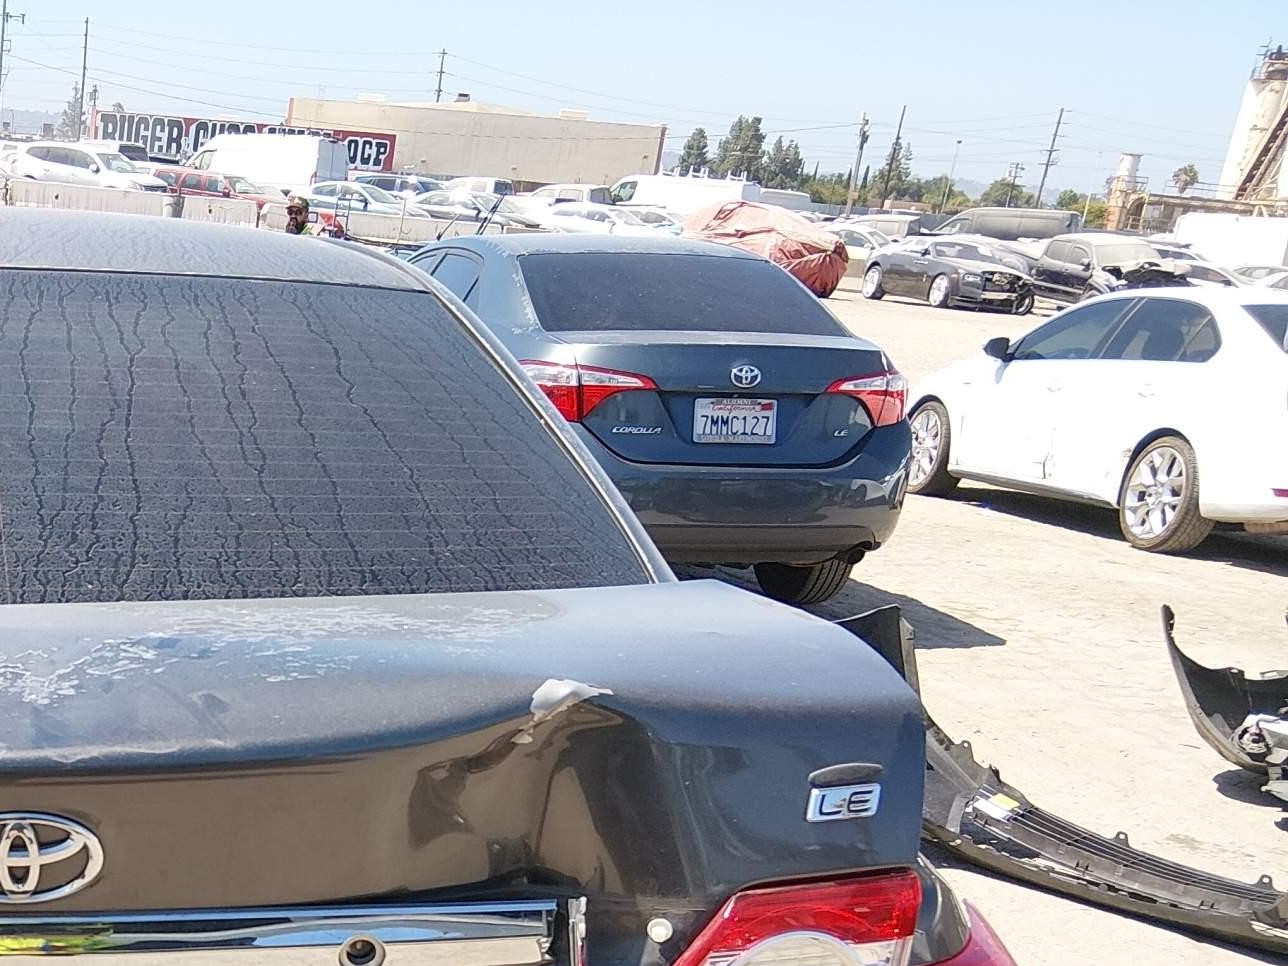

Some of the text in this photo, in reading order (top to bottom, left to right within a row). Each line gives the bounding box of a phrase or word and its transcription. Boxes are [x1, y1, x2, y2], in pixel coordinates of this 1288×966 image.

[612, 426, 662, 434] COROLLA
[700, 414, 771, 437] 7MMC127
[833, 429, 849, 437] LE
[816, 788, 876, 817] LE
